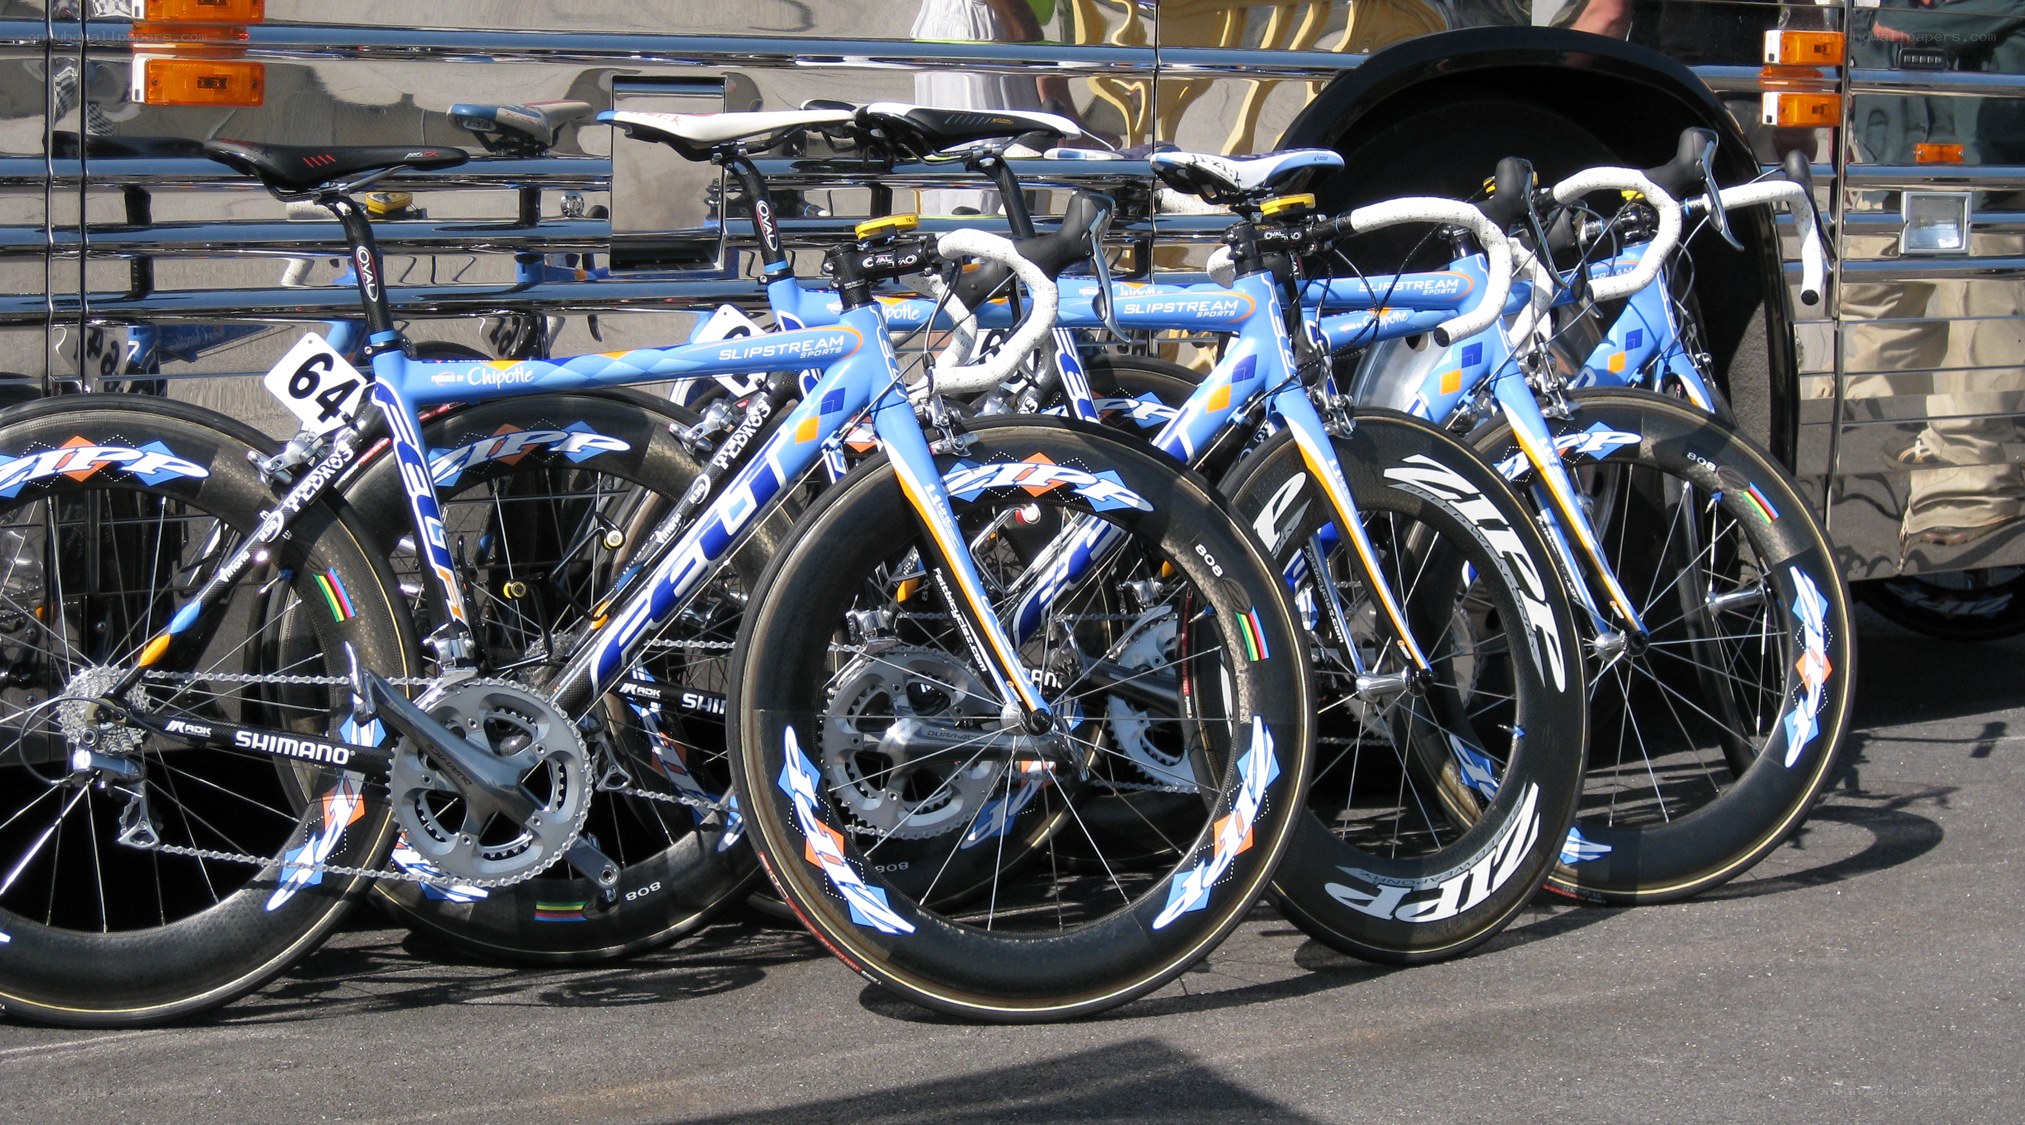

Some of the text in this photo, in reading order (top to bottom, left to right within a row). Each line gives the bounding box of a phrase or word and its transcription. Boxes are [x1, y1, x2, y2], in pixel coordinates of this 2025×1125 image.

[758, 204, 777, 246] OVAL
[357, 250, 378, 296] OVAL
[1422, 287, 1457, 296] SPORTS
[1123, 300, 1239, 315] SLIPSTREAM
[1196, 309, 1236, 318] SPORTS
[718, 334, 845, 361] SLIPSTREAM
[799, 345, 843, 360] SPORTS
[288, 352, 361, 424] 64
[467, 366, 535, 390] Chipotle
[712, 399, 772, 470] PEDROS
[282, 438, 354, 513] PEDROS
[430, 429, 632, 485] ZIPP
[1686, 450, 1718, 472] 808
[941, 462, 1155, 512] ZIPP
[219, 550, 251, 583] Vittoria
[590, 424, 788, 696] FELT
[1194, 543, 1224, 578] 808
[1383, 453, 1566, 693] ZIPP
[1784, 565, 1825, 769] ZIPP
[185, 726, 212, 736] ADK
[234, 730, 350, 765] SHIMANO
[784, 725, 917, 936] ZIPP
[1152, 715, 1275, 931] ZIPP
[874, 861, 910, 873] 808
[1324, 781, 1540, 923] ZIPP
[624, 880, 662, 902] 808
